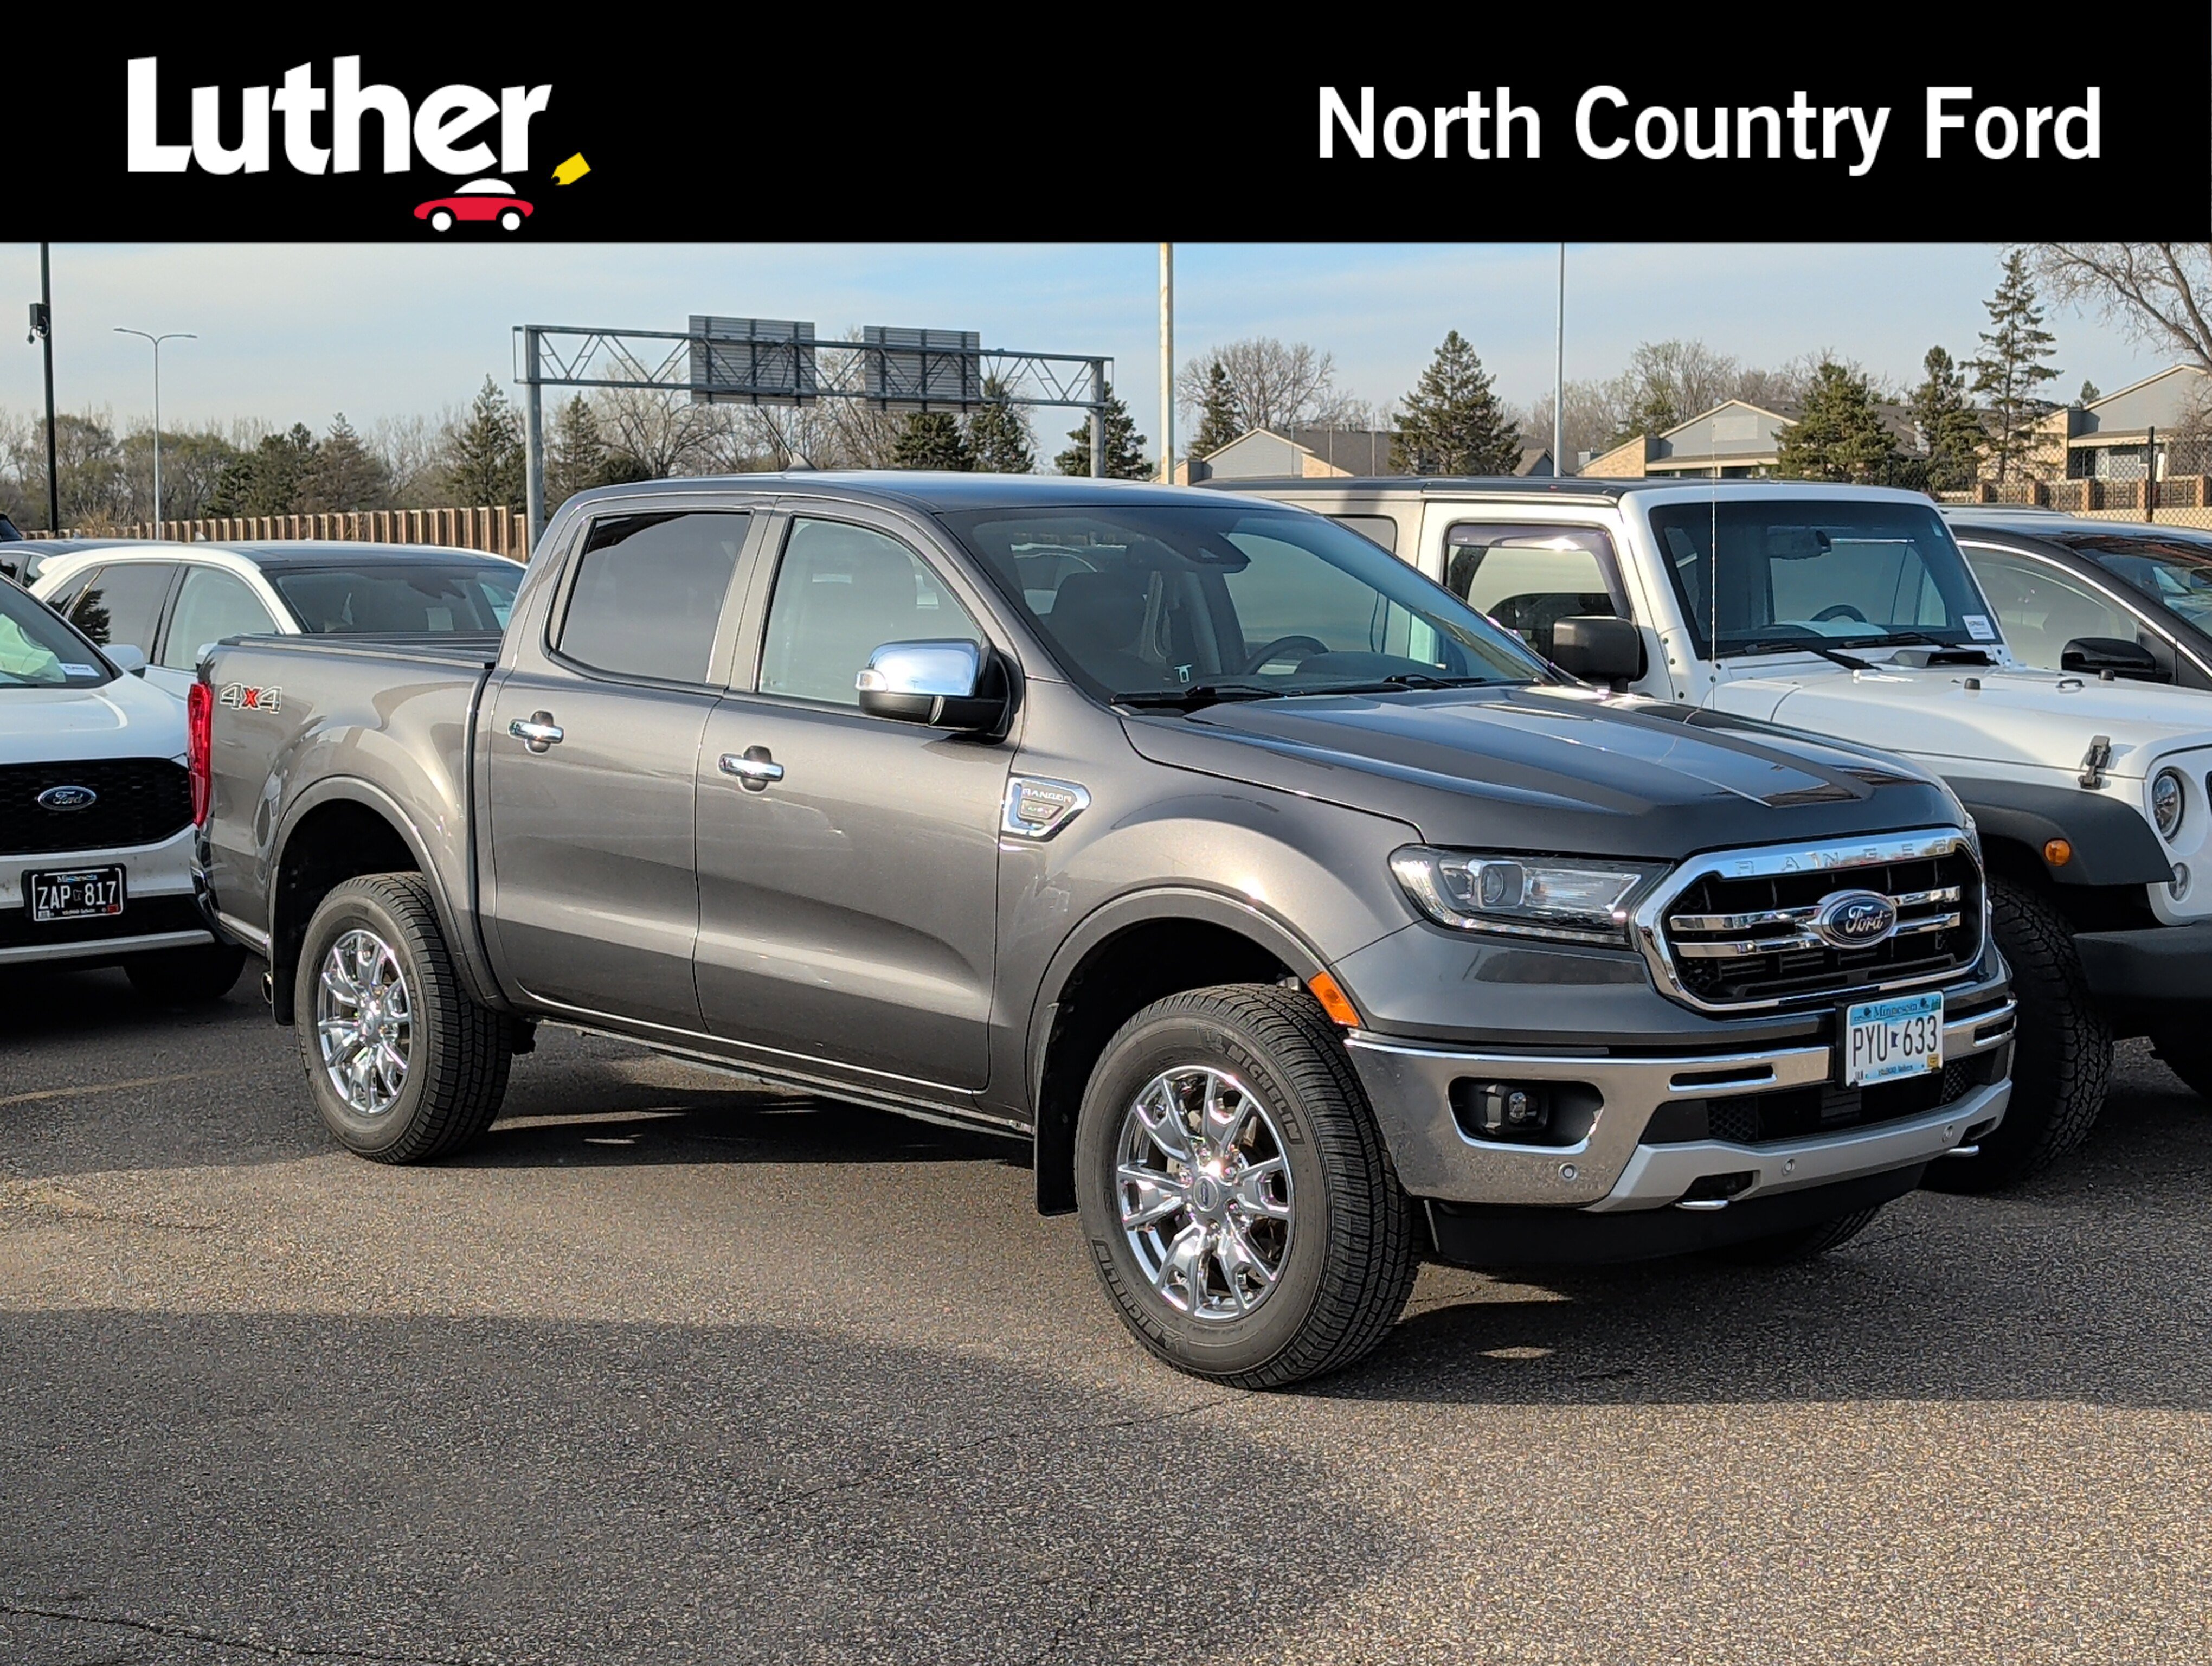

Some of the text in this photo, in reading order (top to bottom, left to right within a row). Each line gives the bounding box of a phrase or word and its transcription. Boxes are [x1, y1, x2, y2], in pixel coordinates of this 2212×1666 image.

[53, 791, 83, 804] Ford
[1735, 838, 1947, 875] RANGER
[37, 881, 117, 909] ZAP 817
[1845, 905, 1885, 934] Ford
[1853, 1015, 1937, 1067] PYU 633
[1227, 1045, 1302, 1140] MICHELIN
